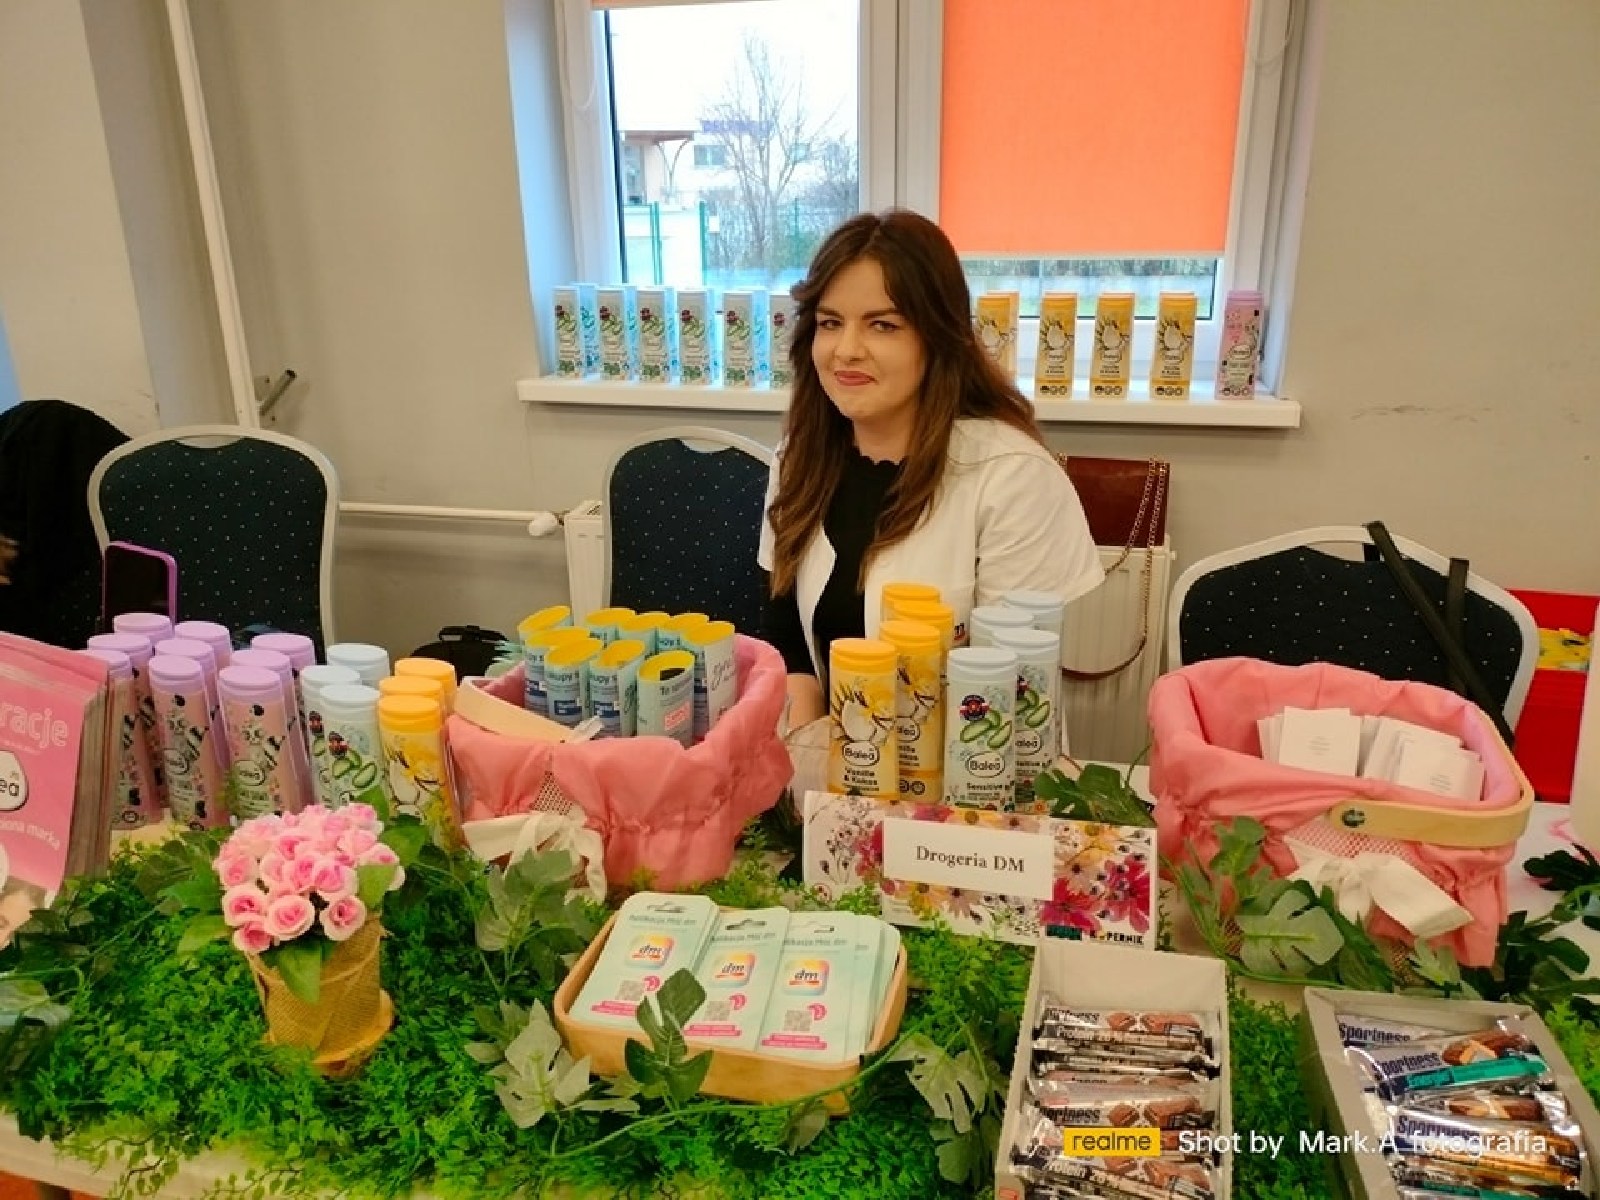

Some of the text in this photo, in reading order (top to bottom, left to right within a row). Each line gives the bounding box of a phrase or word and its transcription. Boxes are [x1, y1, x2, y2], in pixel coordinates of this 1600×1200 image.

[969, 758, 1001, 771] Balea
[916, 845, 1025, 873] Drogeria DM
[794, 968, 819, 980] dm
